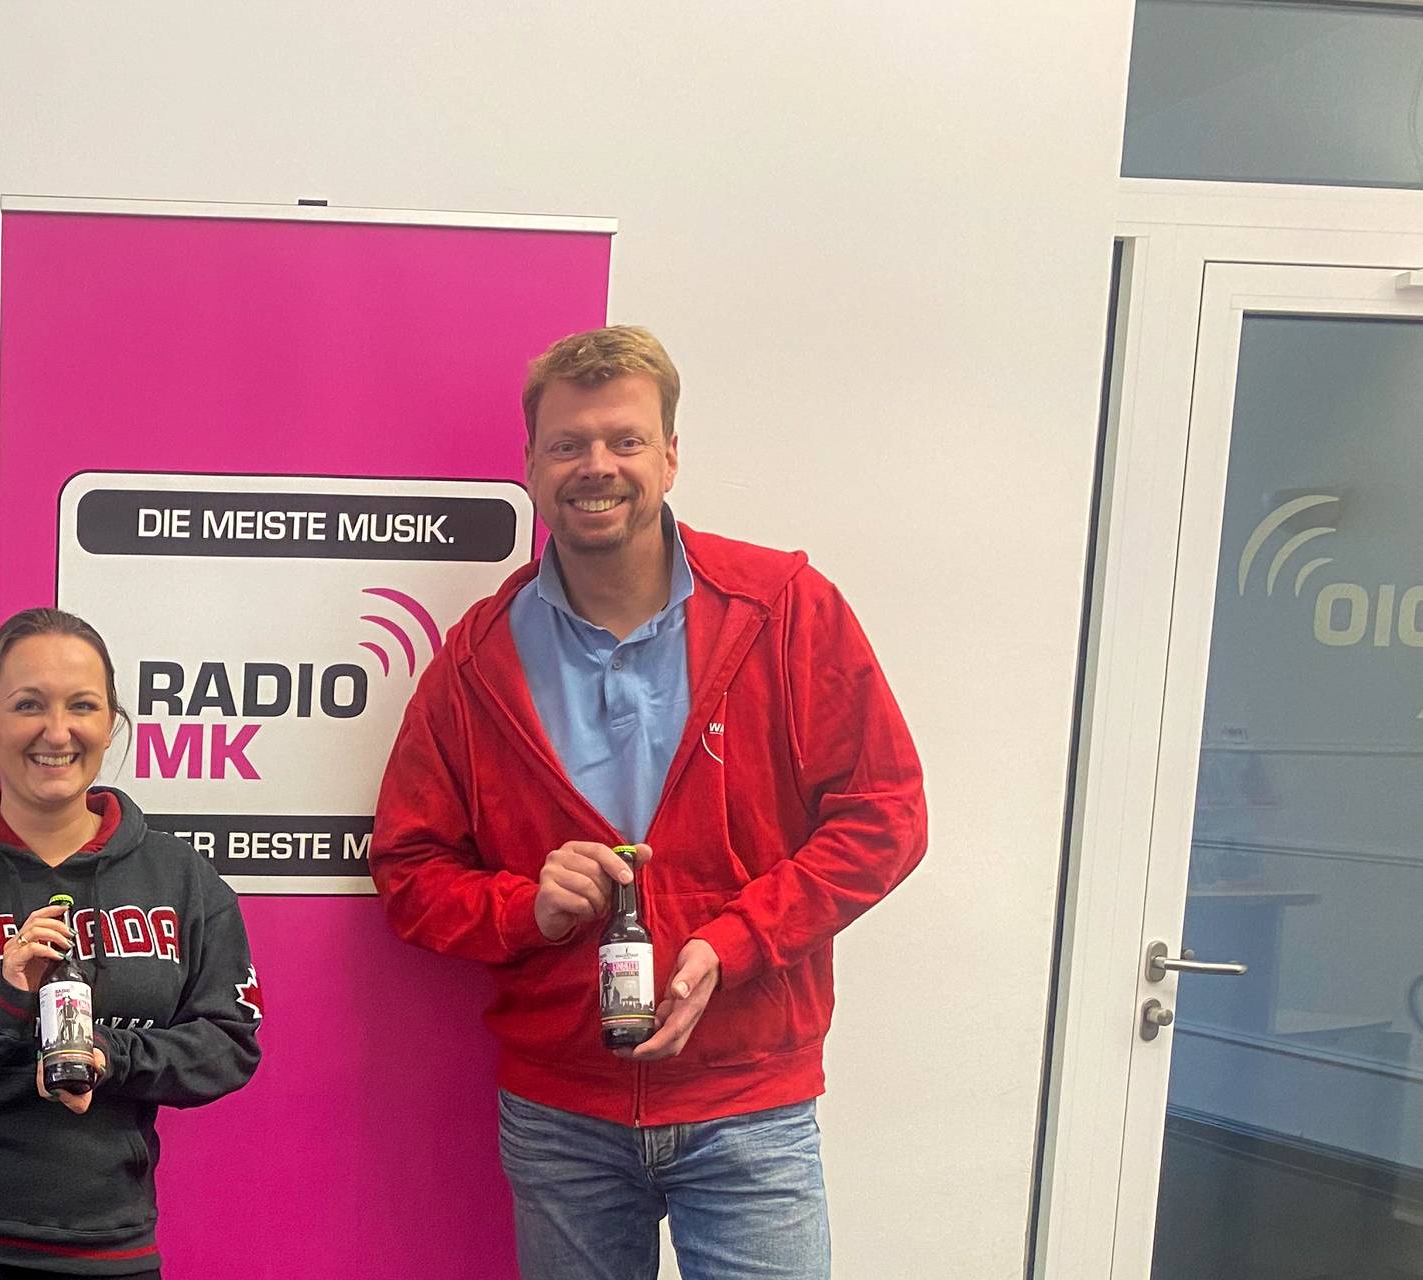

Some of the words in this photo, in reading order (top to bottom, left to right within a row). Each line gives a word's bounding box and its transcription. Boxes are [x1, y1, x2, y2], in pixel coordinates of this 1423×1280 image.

[137, 508, 190, 539] DIE
[201, 510, 327, 542] MEISTE
[336, 513, 456, 545] MUSIK.
[137, 660, 369, 719] RADIO
[134, 722, 263, 781] MK
[228, 832, 332, 860] BESTE
